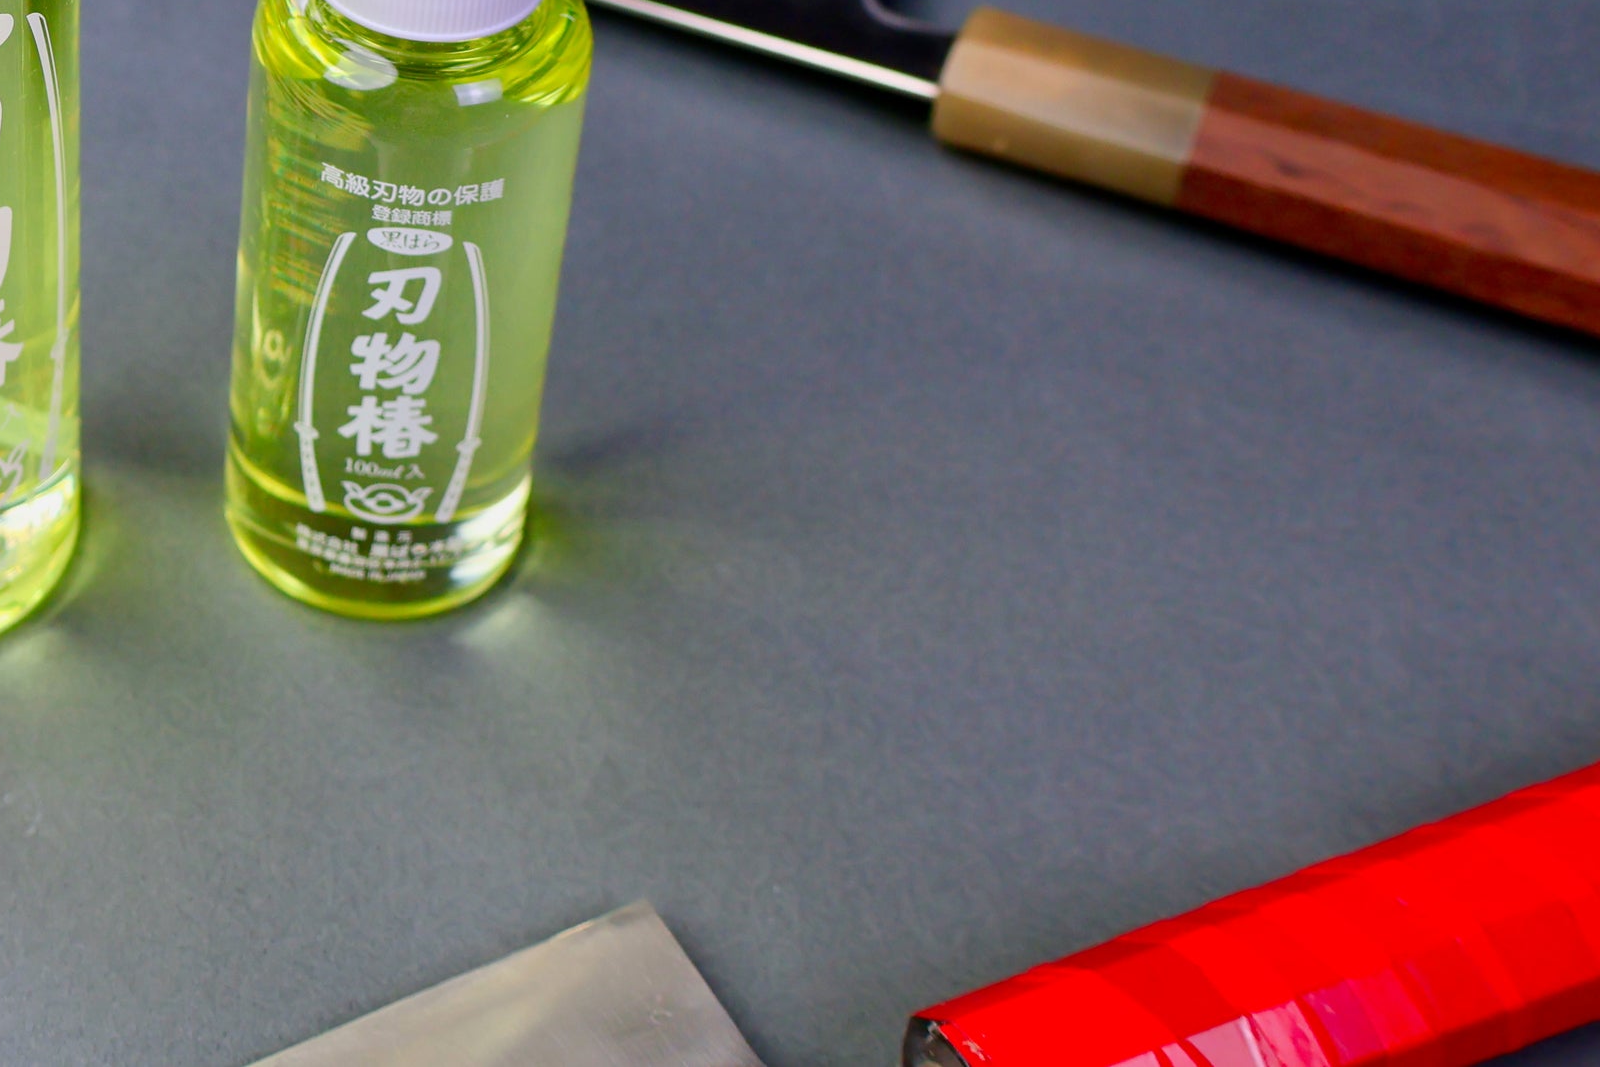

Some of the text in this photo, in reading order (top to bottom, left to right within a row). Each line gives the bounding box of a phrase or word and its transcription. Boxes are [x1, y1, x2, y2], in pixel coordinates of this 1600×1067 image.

[320, 162, 504, 206] 高級刃物の保護
[371, 204, 452, 226] 登録商標
[338, 266, 438, 458] 刃物椿
